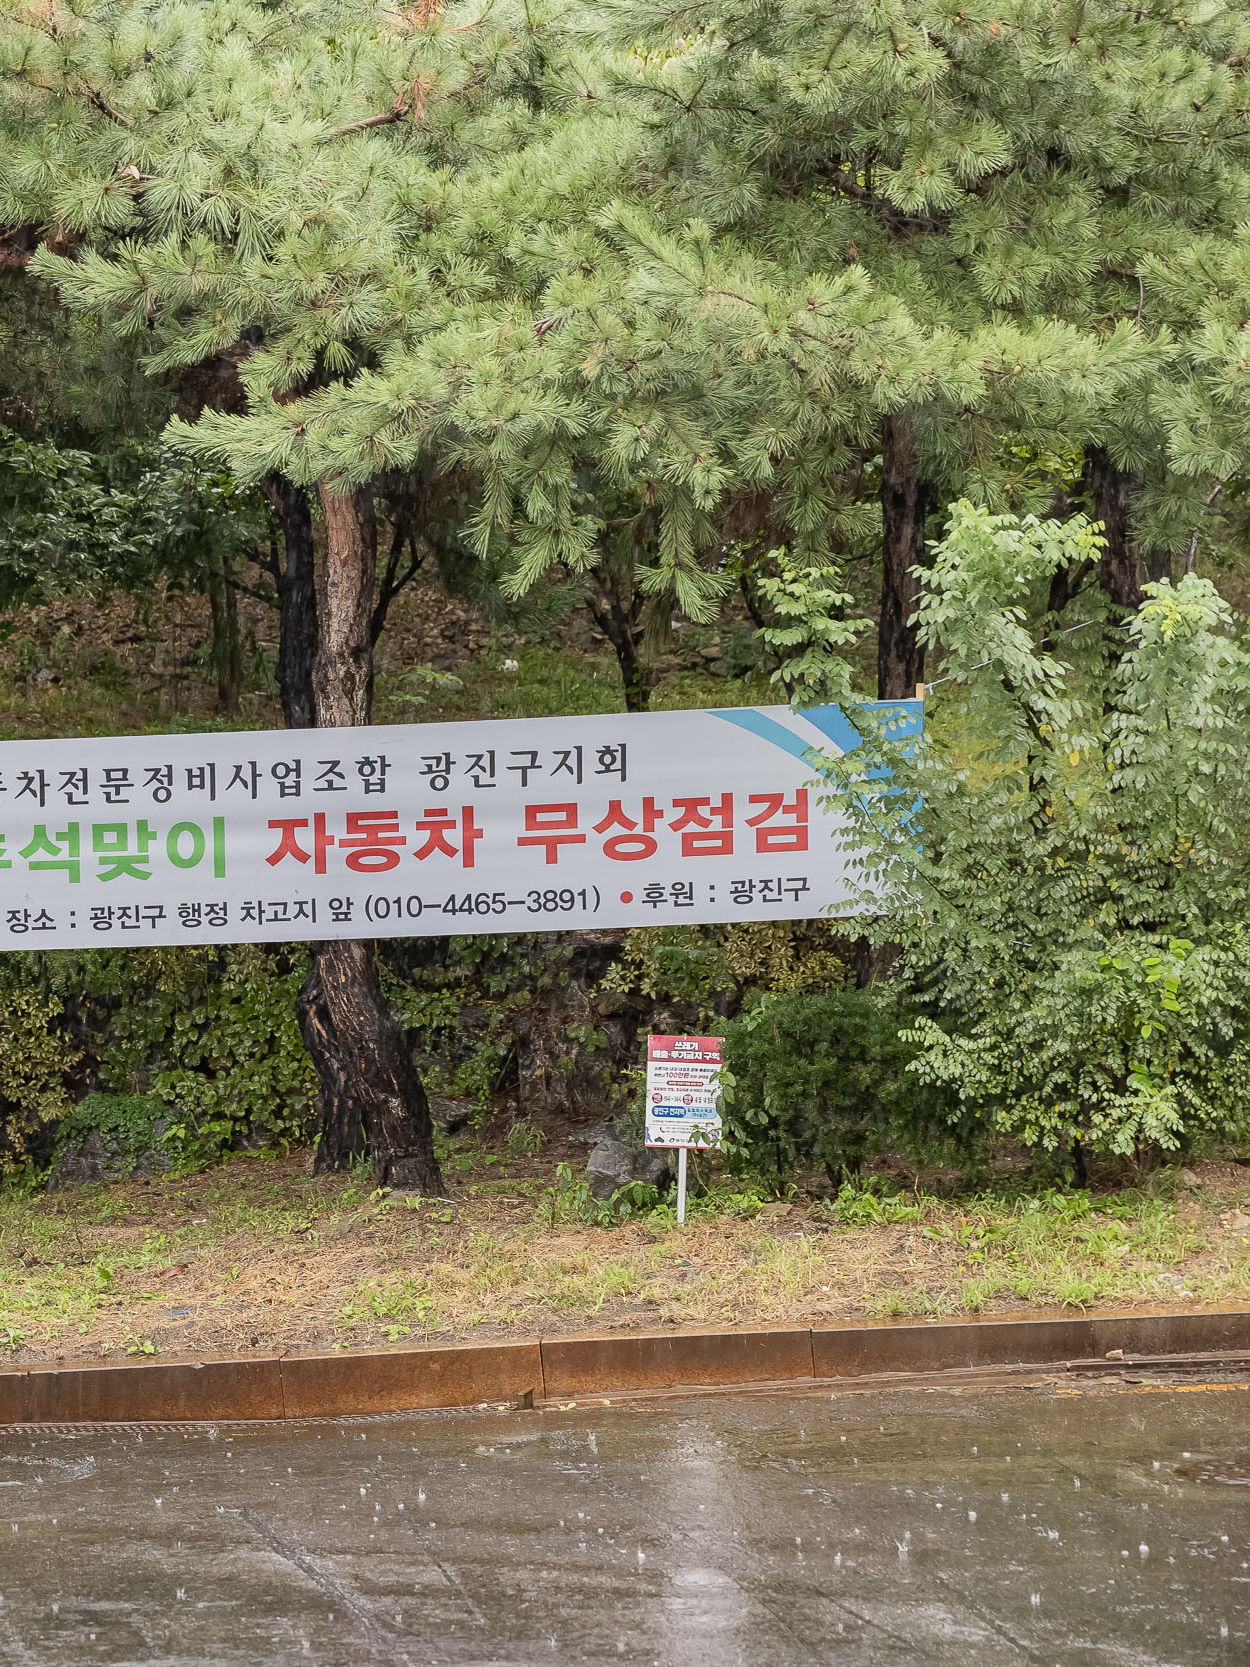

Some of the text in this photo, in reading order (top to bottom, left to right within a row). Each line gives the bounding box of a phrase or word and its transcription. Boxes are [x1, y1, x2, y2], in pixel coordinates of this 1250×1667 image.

[419, 744, 626, 791] 광진구지회
[265, 806, 483, 874] 자동차
[518, 789, 809, 864] 무상점검
[6, 909, 56, 933] 장소
[90, 905, 166, 930] 광진구
[178, 902, 228, 927] 행정
[240, 898, 316, 925] 차고지
[329, 897, 353, 922] 앞
[365, 886, 600, 922] (010-4465-3891)
[642, 882, 694, 908] 후원
[730, 878, 810, 904] 광진구
[674, 1041, 699, 1050] 쓰레기
